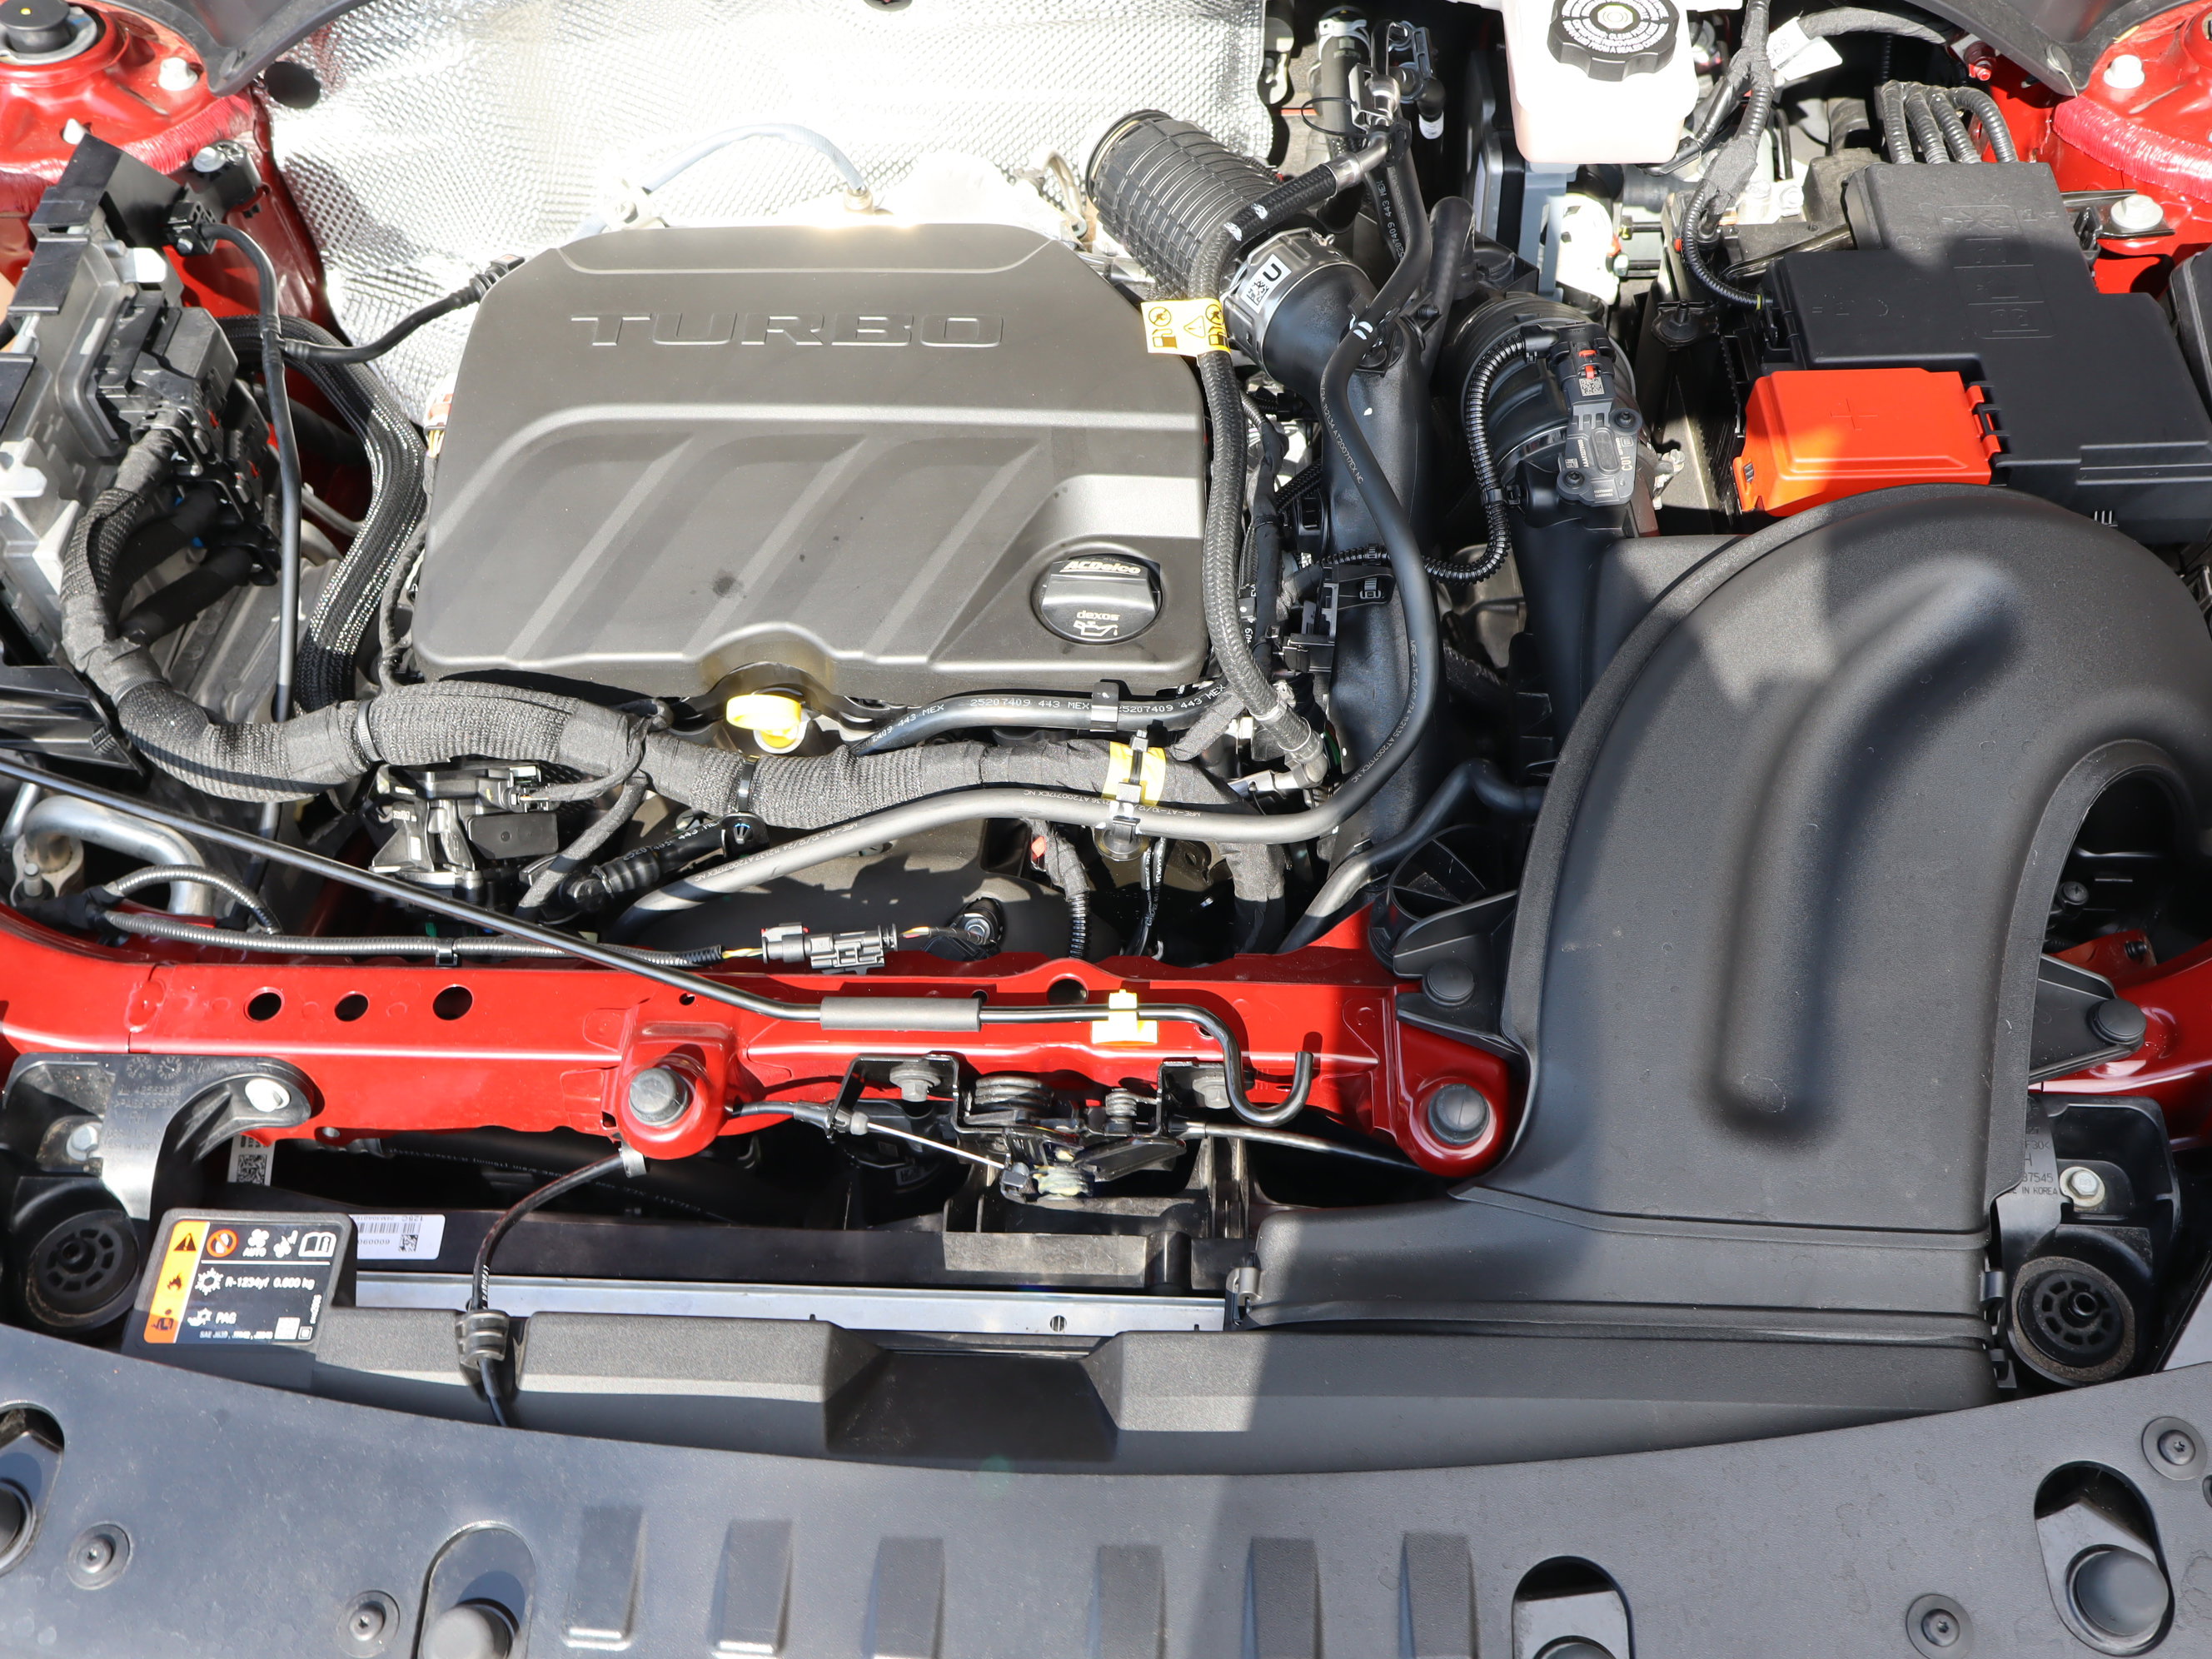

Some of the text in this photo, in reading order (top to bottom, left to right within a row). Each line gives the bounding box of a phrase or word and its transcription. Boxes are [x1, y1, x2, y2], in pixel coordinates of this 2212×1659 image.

[1263, 262, 1283, 282] U
[570, 312, 1004, 348] TURBO
[1059, 560, 1141, 576] ACDelco
[1076, 610, 1121, 621] dexos
[969, 698, 1090, 710] 25207409 443 MEX
[1180, 698, 1203, 709] 443
[1204, 684, 1226, 700] MEX
[898, 713, 917, 727] 443
[922, 704, 945, 716] MEX
[2021, 1186, 2030, 1194] IN
[2033, 1187, 2059, 1195] KOREA
[225, 1276, 270, 1290] R-1234yf
[301, 1278, 316, 1291] kg
[215, 1312, 237, 1324] PAG
